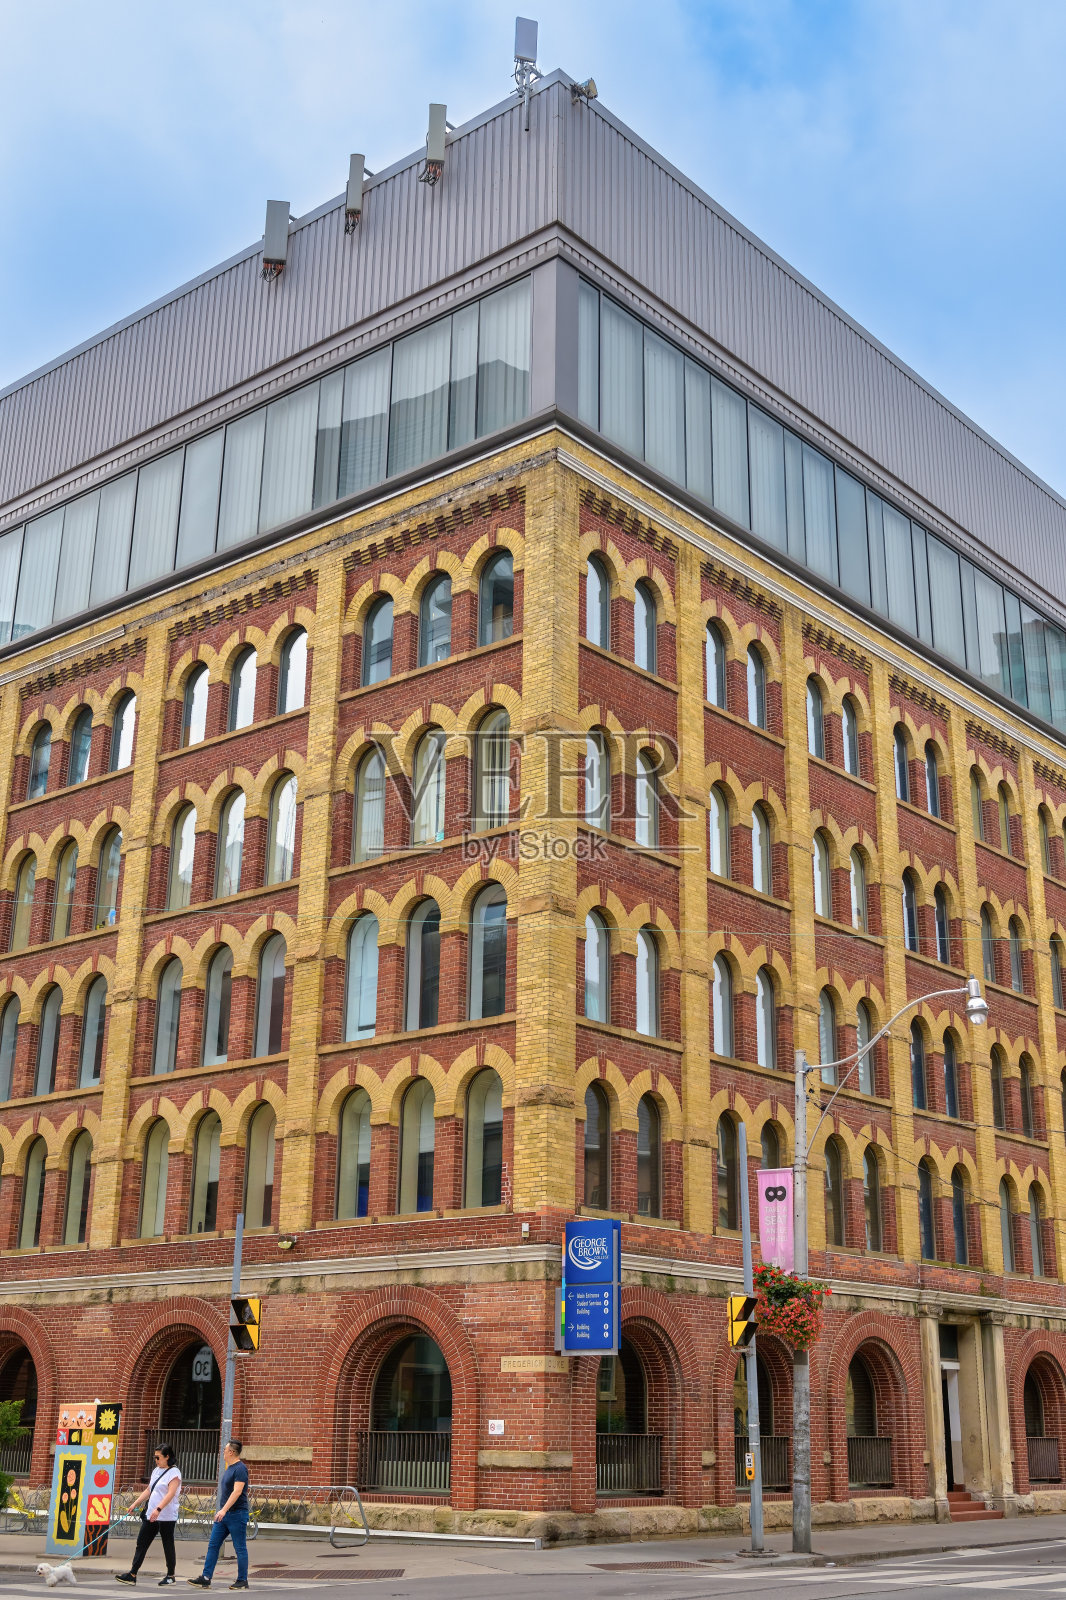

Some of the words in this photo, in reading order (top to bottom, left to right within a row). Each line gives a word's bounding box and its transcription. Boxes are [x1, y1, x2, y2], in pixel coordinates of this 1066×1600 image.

[764, 1215, 787, 1225] SEAT
[574, 1237, 607, 1249] GEORGE
[578, 1246, 608, 1257] BROWN
[503, 1359, 543, 1369] FREDERICK
[547, 1359, 565, 1369] DUKE
